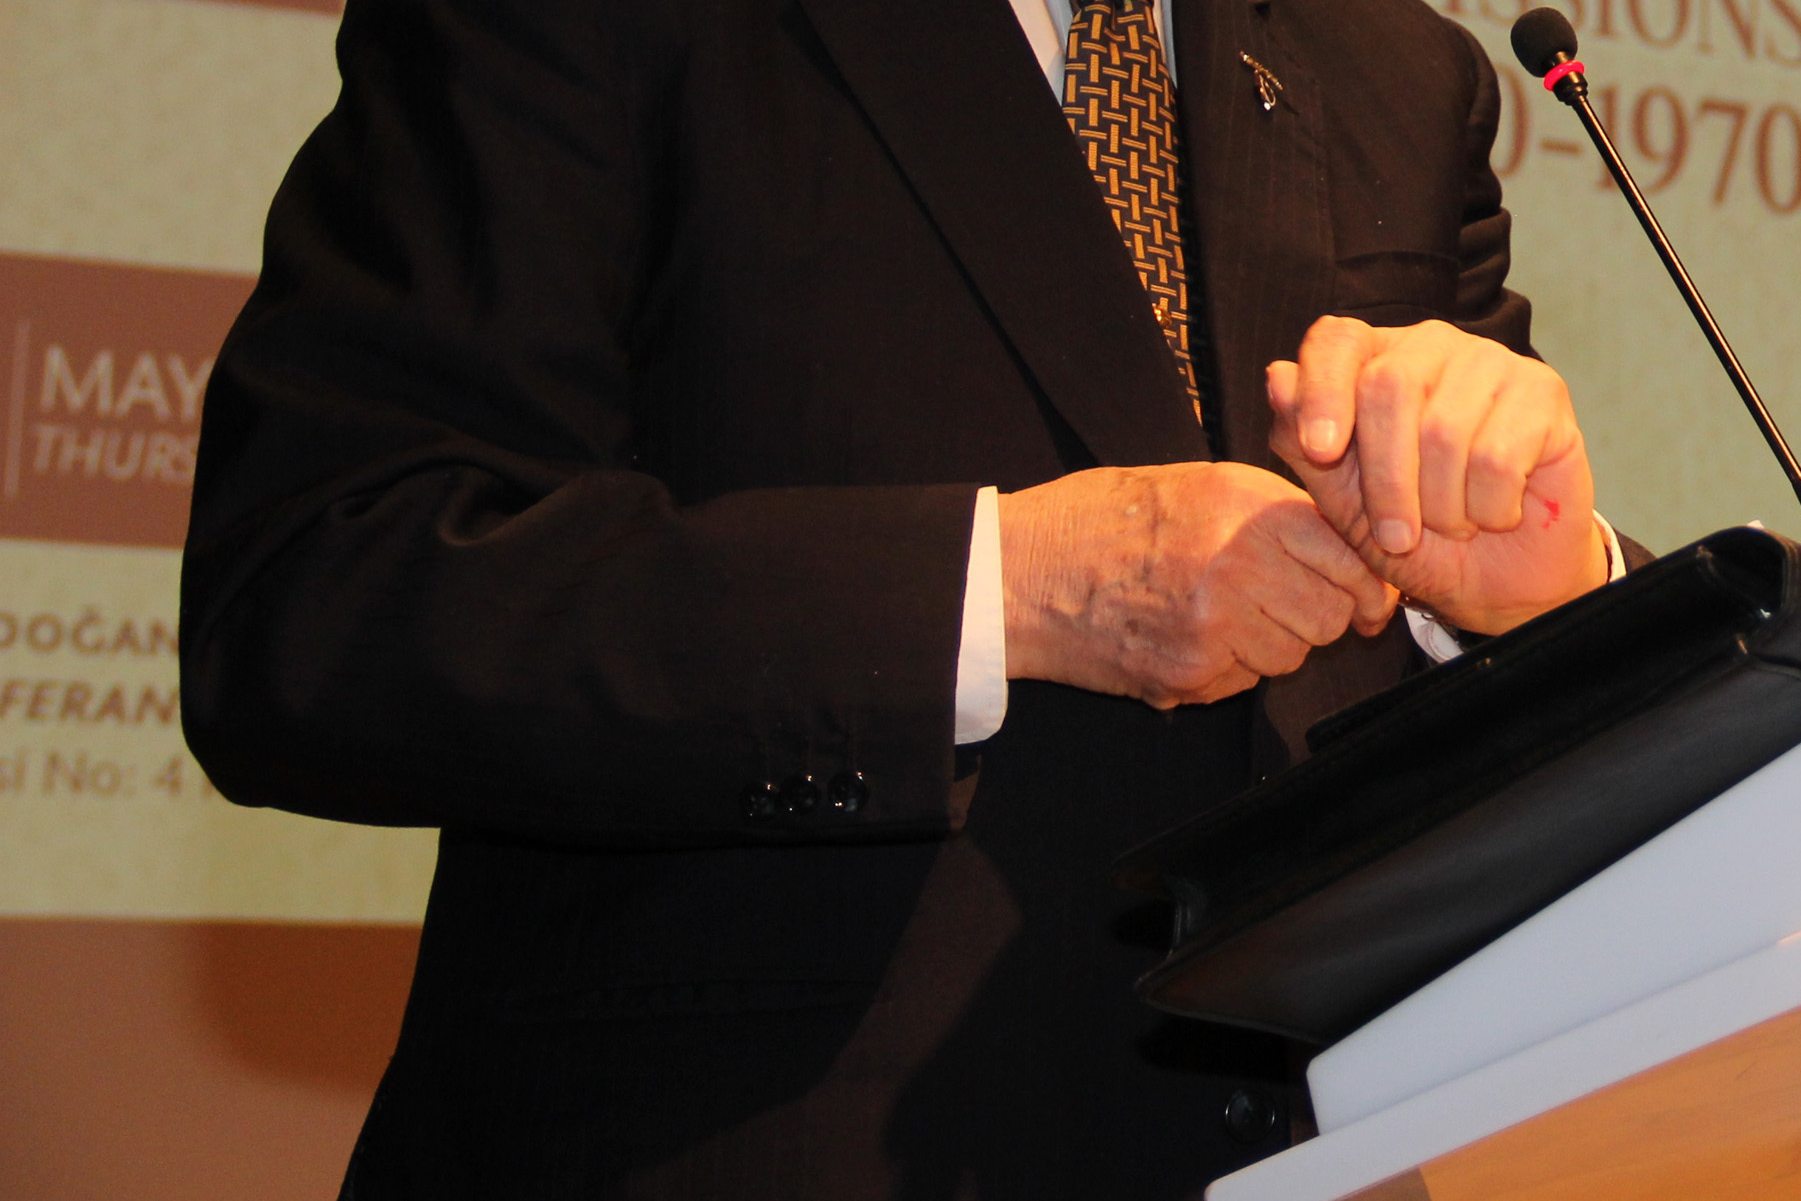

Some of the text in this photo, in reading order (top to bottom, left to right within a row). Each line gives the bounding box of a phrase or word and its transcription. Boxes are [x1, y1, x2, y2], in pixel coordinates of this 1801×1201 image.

[39, 342, 211, 421] MAY
[33, 422, 199, 484] THURS
[0, 677, 179, 725] FERAN
